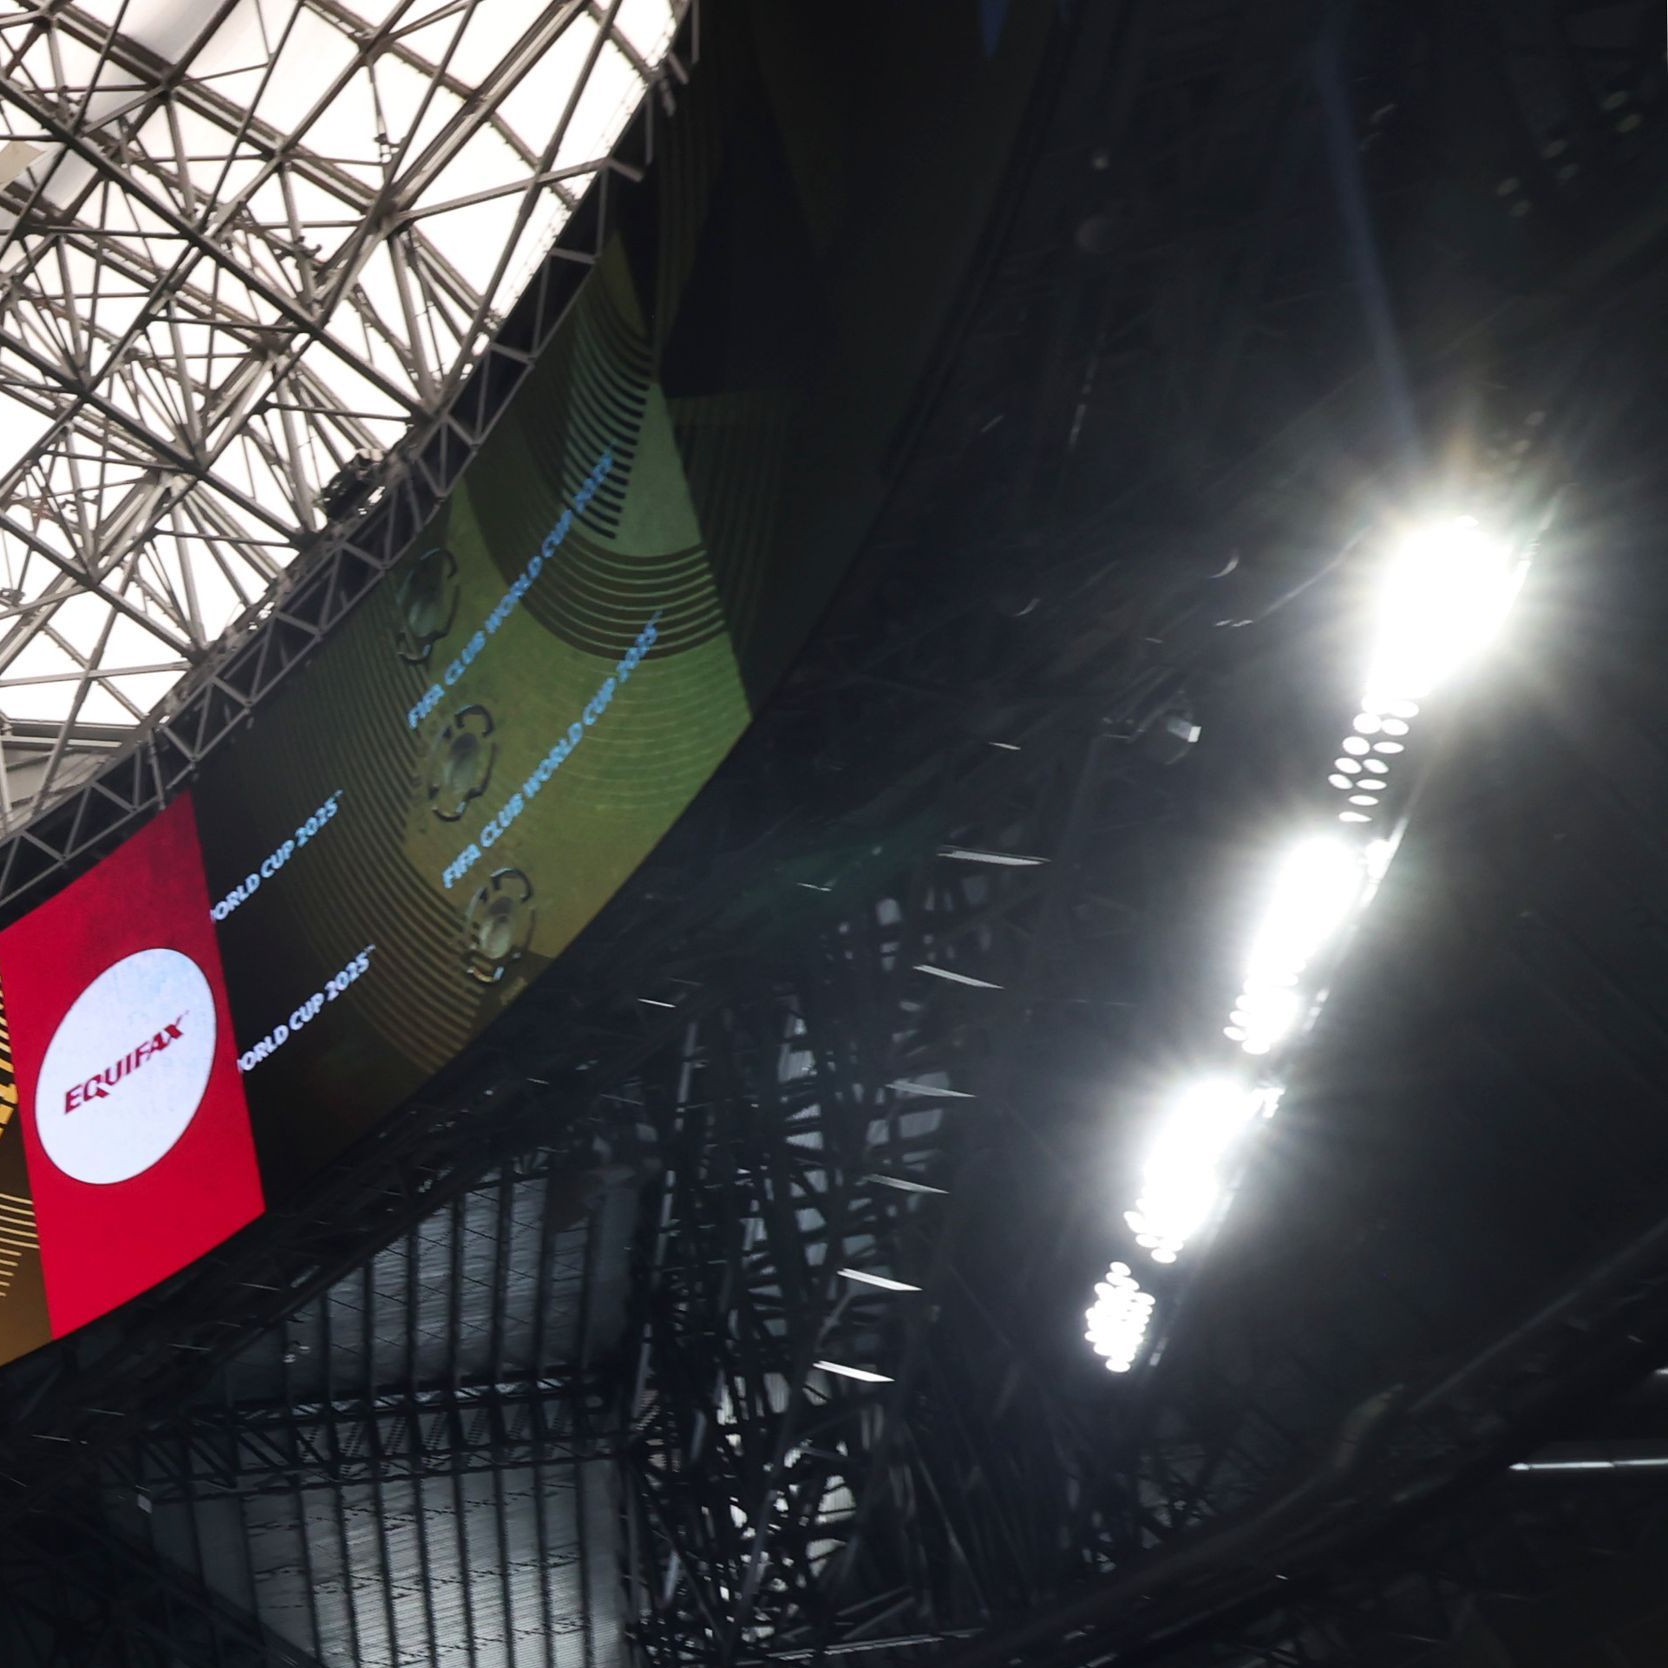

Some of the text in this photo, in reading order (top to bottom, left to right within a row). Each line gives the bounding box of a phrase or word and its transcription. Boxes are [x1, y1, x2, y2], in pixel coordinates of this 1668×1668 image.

[260, 838, 297, 880] CUP
[443, 842, 481, 890] FIFA
[288, 989, 326, 1034] CUP
[64, 1015, 185, 1115] EQUIFAX
